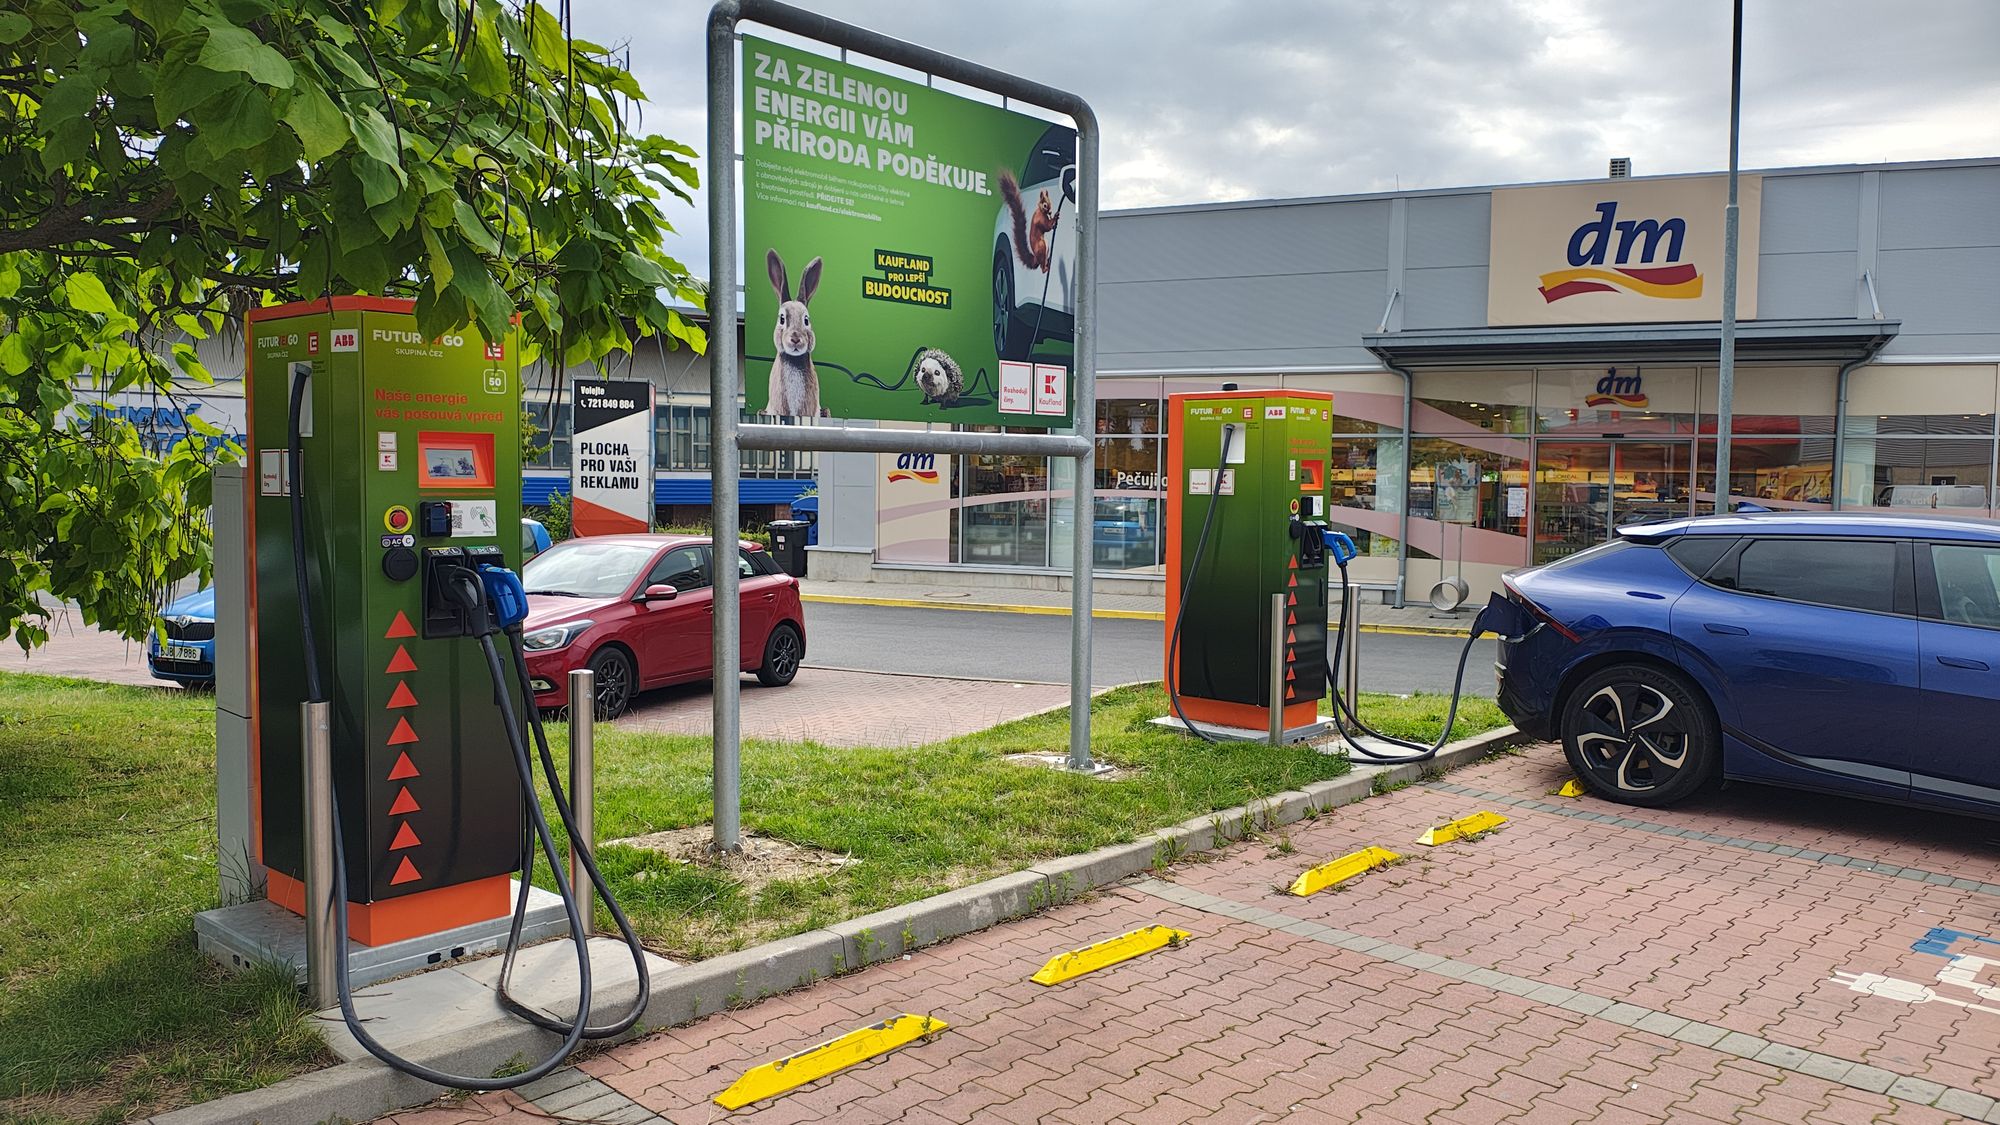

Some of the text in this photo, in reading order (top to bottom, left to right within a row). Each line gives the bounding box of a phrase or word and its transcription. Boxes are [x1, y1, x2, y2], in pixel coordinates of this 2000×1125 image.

[755, 52, 908, 115] ZA ZELENOU
[755, 86, 914, 148] ENERGII VÁM
[755, 118, 992, 196] PŘÍRODA PODĚKUJE.
[756, 191, 770, 200] Více
[1567, 201, 1686, 267] dm
[878, 254, 930, 271] KAUFLAND
[888, 272, 926, 283] PRO LEPŠÍ
[865, 281, 949, 305] BUDOUCNOST
[334, 334, 355, 348] ABB
[395, 348, 444, 358] SKUPINA ČEZ
[488, 377, 502, 387] 50
[1596, 366, 1642, 396] dm
[374, 388, 468, 406] Naše energie
[580, 385, 605, 396] Volejte
[587, 399, 602, 408] 721
[602, 399, 618, 409] 849
[1039, 398, 1063, 406] Kaufland
[375, 408, 400, 419] vás
[403, 409, 463, 421] posouvá
[580, 442, 630, 456] PLOCHA
[580, 457, 637, 473] PRO VAŠI
[580, 475, 639, 490] REKLAMU
[405, 537, 411, 545] C
